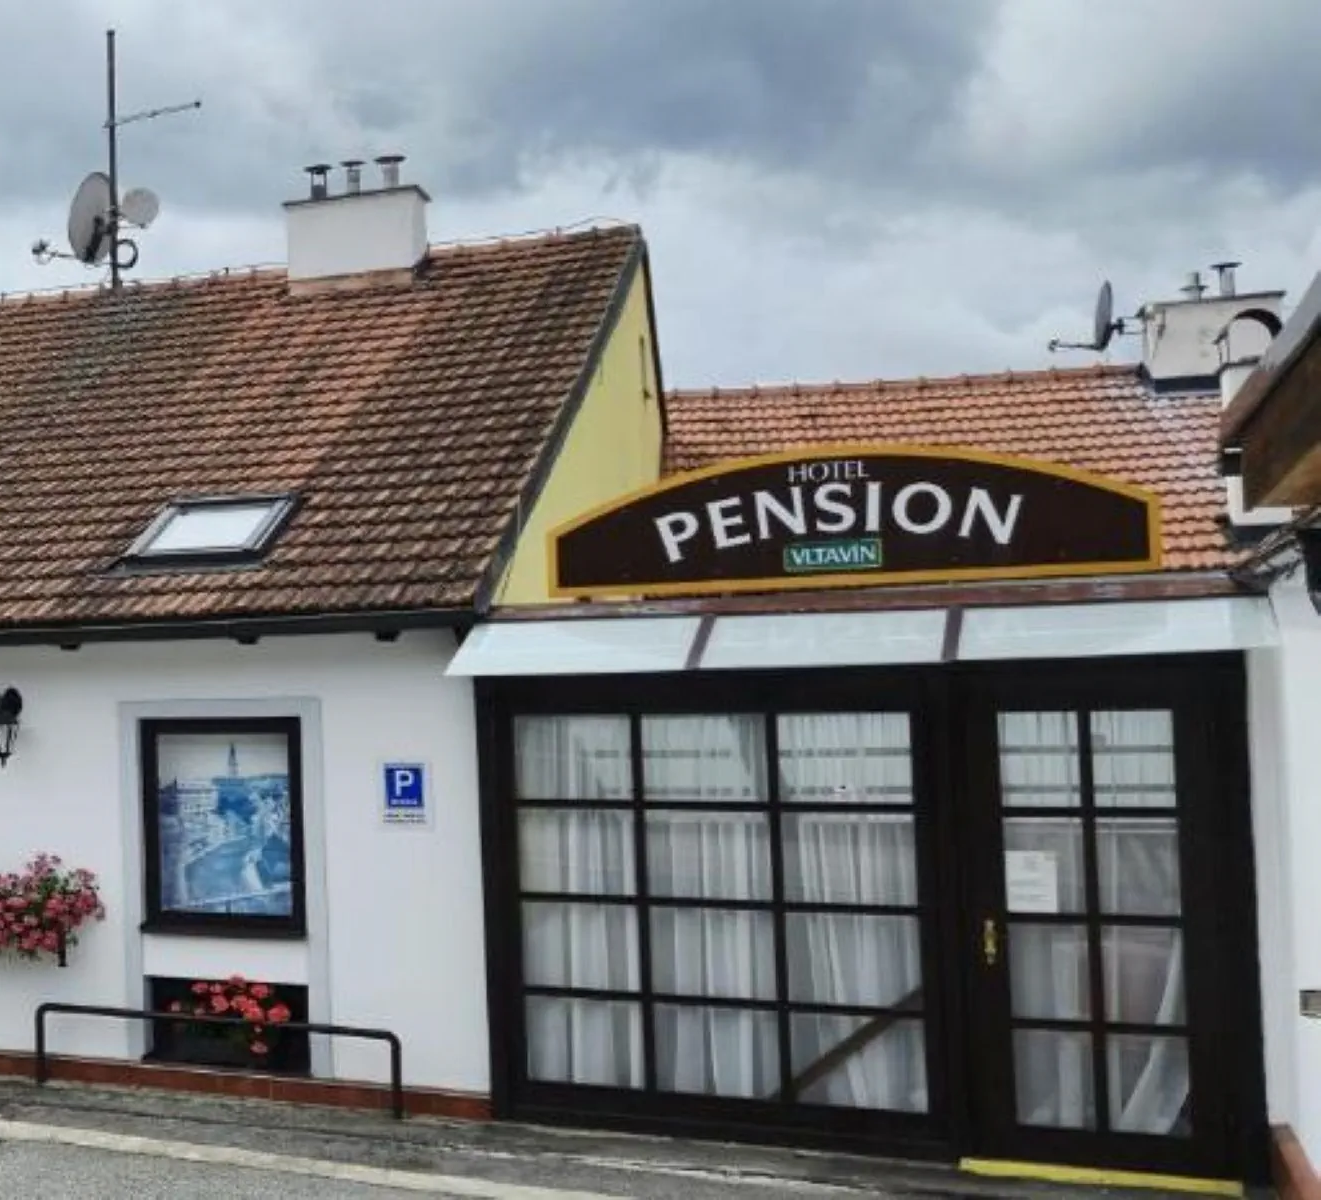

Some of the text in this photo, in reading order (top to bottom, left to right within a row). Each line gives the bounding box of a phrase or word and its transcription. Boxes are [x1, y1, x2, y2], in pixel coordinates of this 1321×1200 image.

[788, 460, 869, 482] HOTEL
[654, 481, 1023, 562] PENSION
[396, 770, 413, 797] P
